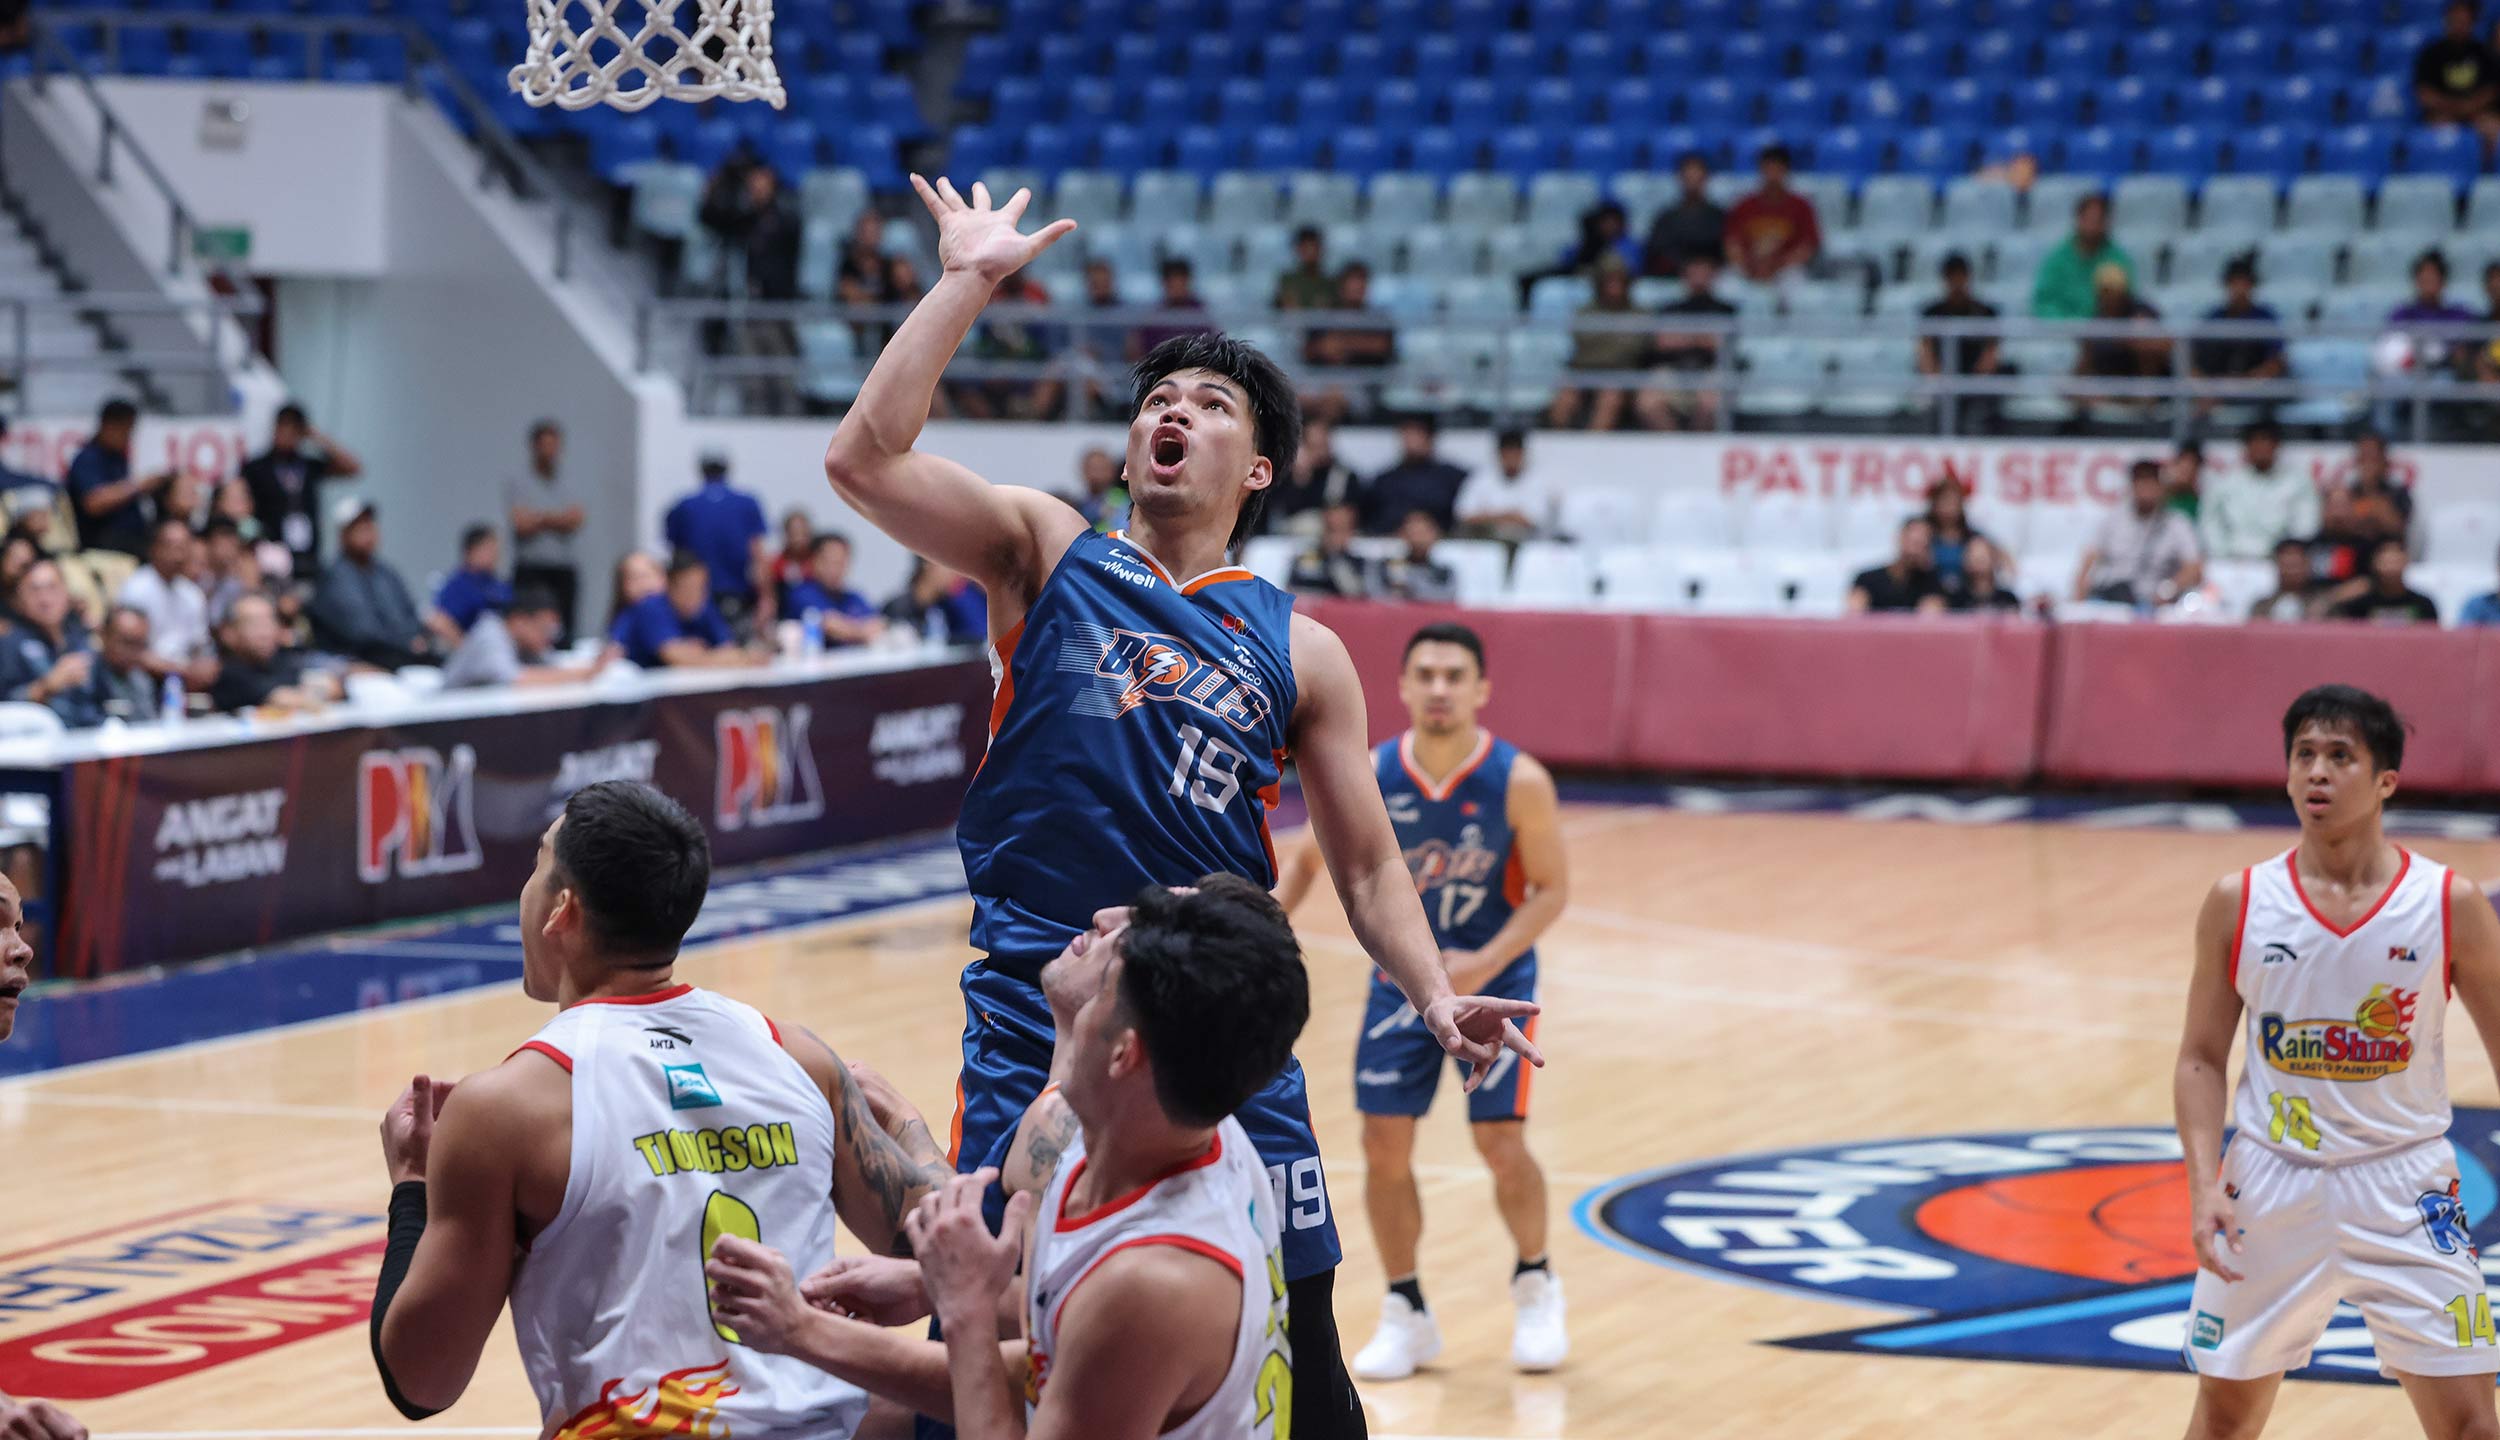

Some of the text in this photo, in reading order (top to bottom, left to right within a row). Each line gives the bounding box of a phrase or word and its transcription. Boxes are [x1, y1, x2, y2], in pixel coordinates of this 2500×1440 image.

[1721, 449, 1979, 502] PATRON
[1095, 628, 1271, 733] BOLTS
[1219, 656, 1262, 686] MERALCO
[1168, 722, 1248, 814] 19
[153, 787, 287, 853] ANGAT
[1438, 882, 1488, 931] 17
[2388, 947, 2418, 961] PBA
[2269, 1091, 2322, 1151] 14
[2444, 1292, 2497, 1348] 14
